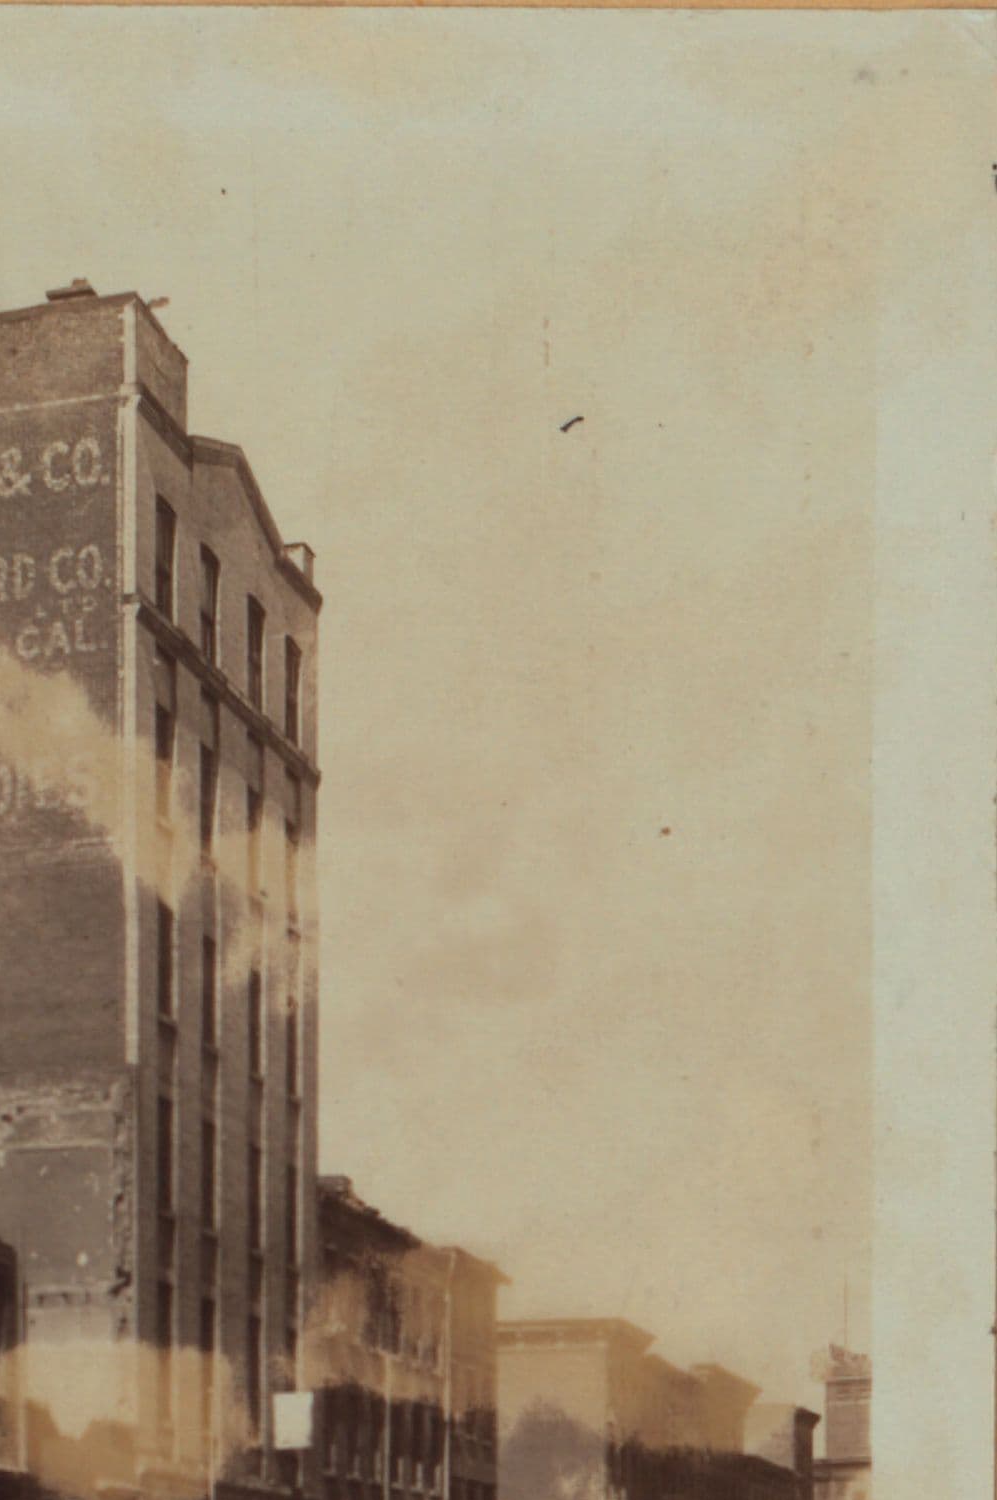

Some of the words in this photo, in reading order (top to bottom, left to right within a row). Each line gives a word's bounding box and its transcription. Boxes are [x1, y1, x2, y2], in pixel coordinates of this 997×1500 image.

[42, 437, 110, 493] CO.
[50, 545, 112, 594] CO.
[15, 620, 109, 662] CAL.
